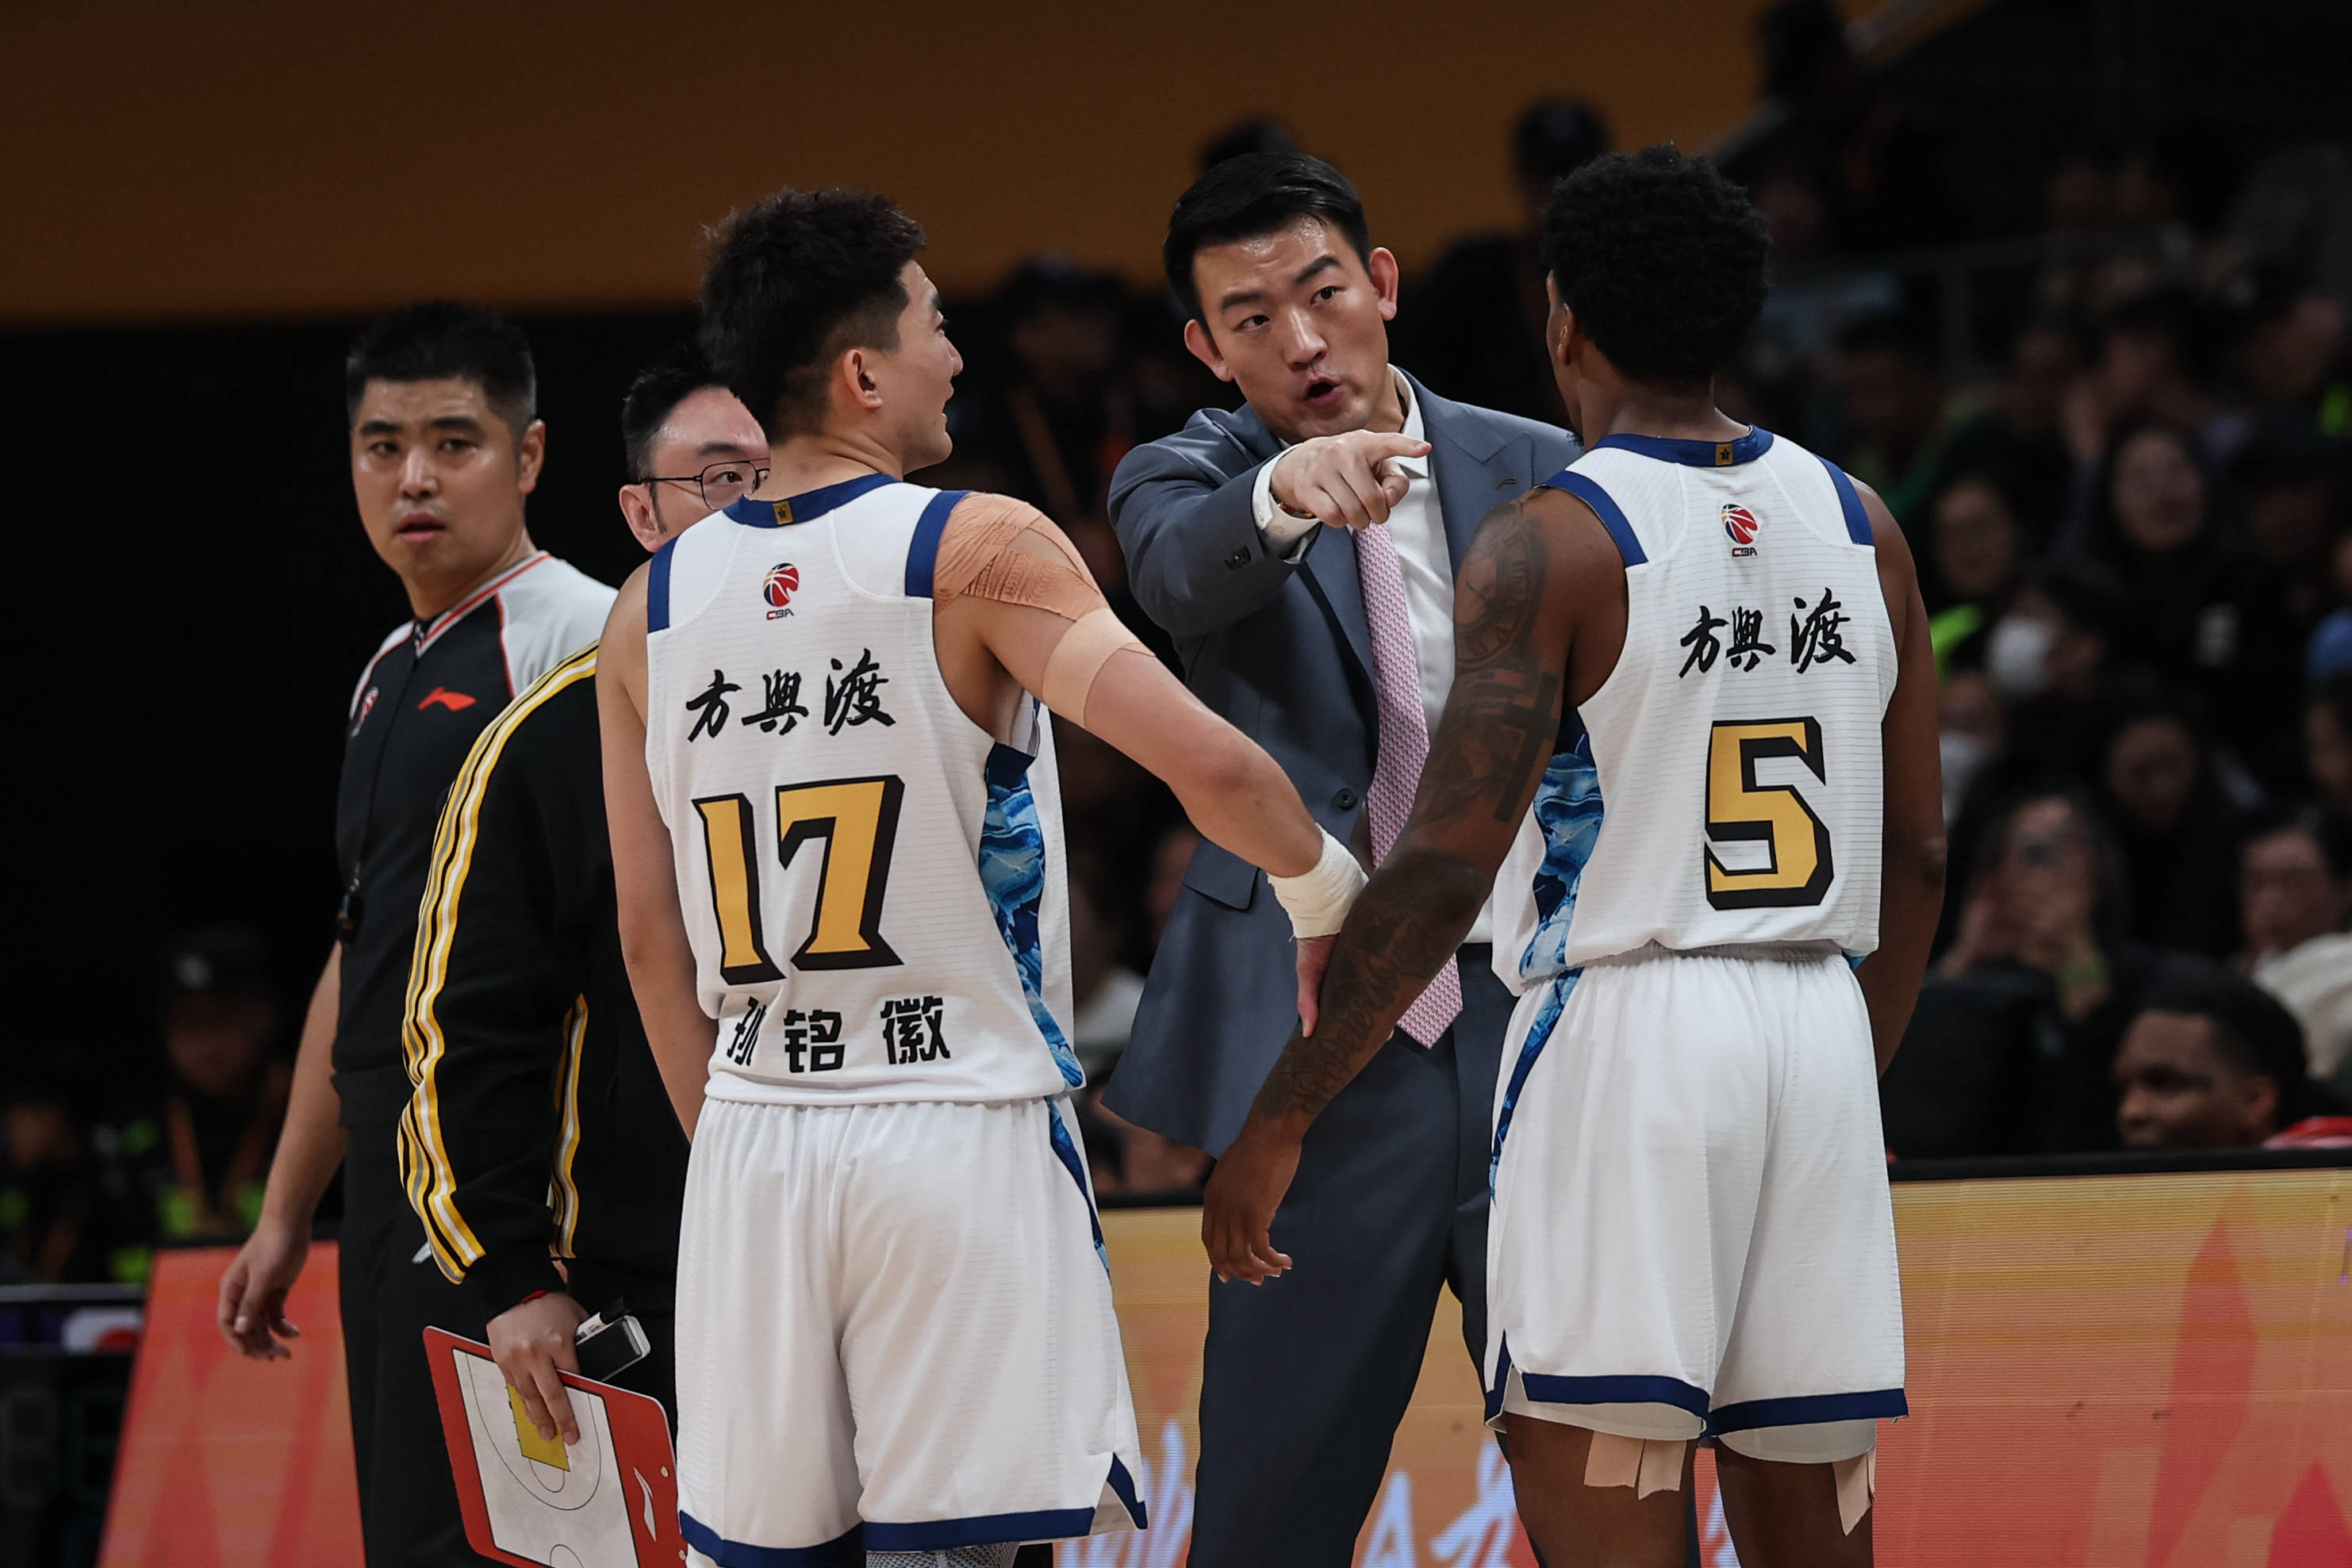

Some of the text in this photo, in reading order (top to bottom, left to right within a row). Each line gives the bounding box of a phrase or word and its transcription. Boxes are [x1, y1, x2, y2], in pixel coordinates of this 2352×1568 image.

[1732, 547, 1758, 558] CBA
[766, 608, 795, 620] CBA
[1703, 715, 1835, 911] 5
[691, 774, 906, 986] 17
